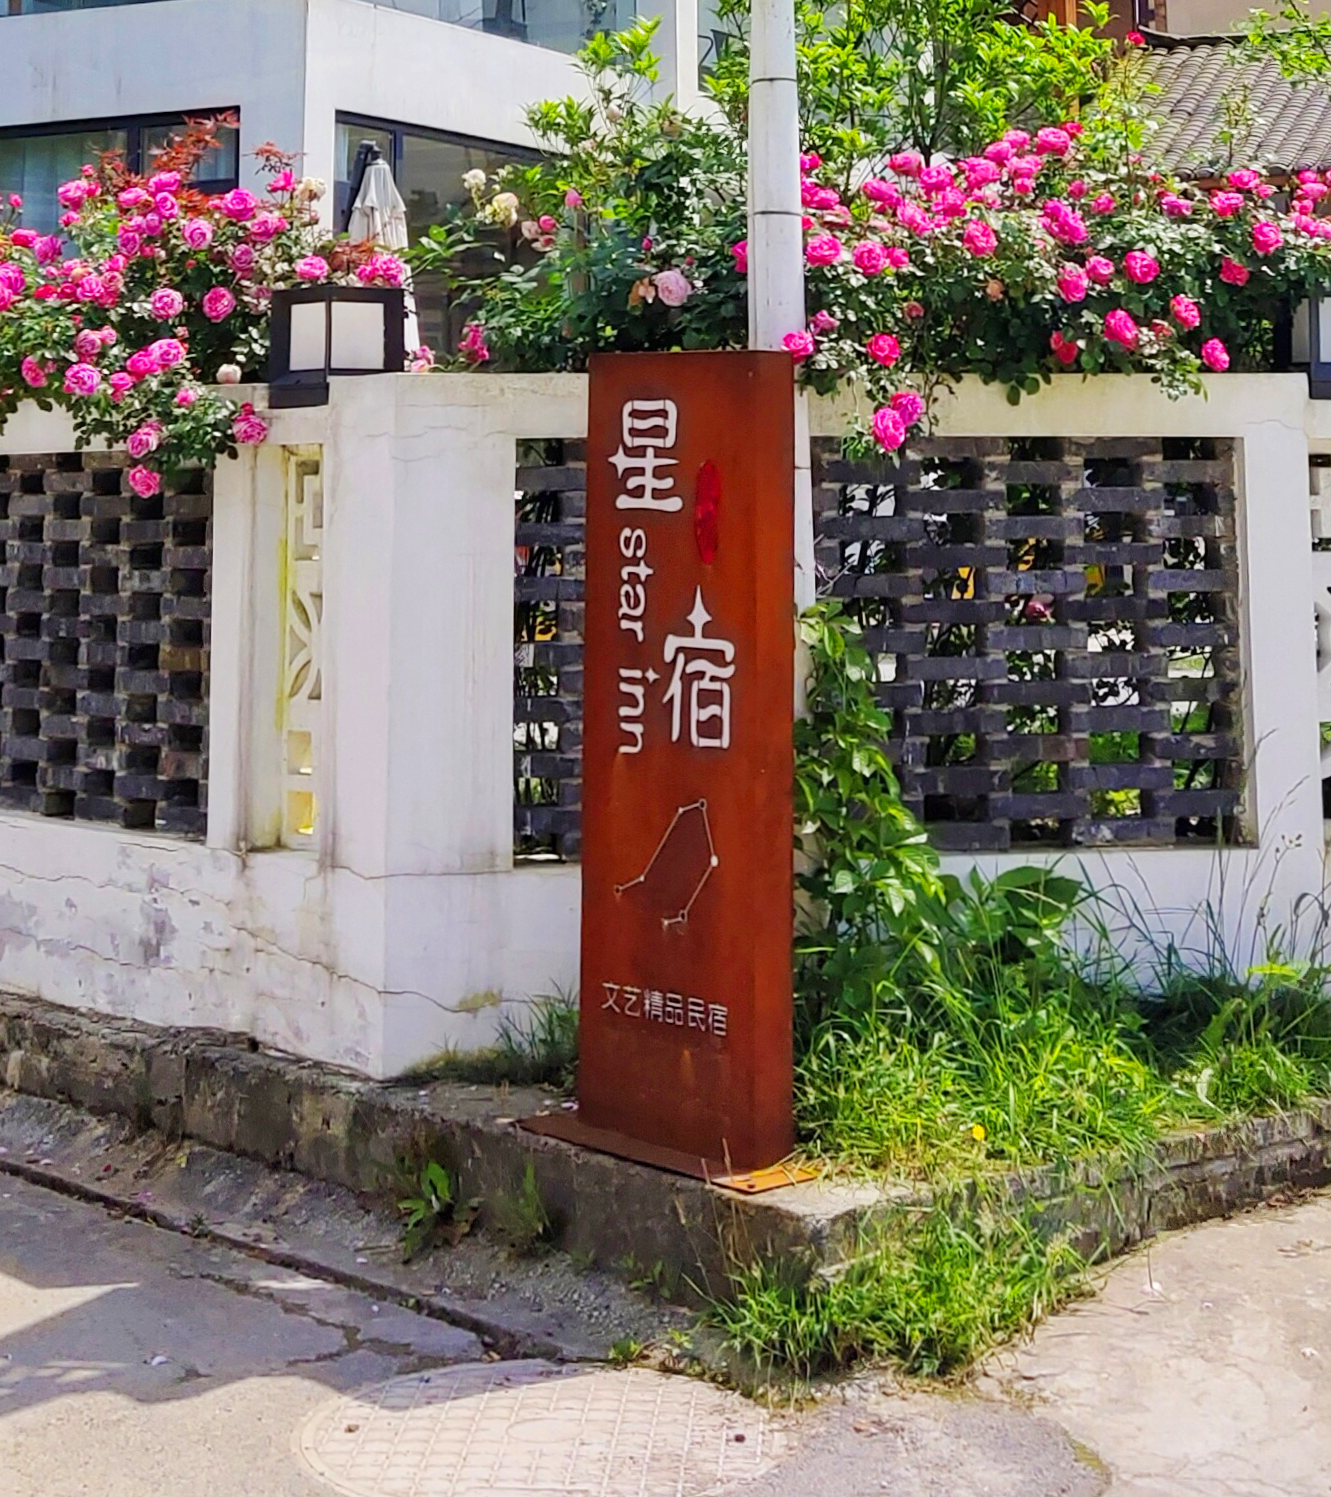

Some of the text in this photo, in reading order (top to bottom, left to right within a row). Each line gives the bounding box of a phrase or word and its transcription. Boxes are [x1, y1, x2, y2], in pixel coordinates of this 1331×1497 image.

[618, 526, 661, 754] star inn
[601, 982, 728, 1036] 文艺精品民宿
